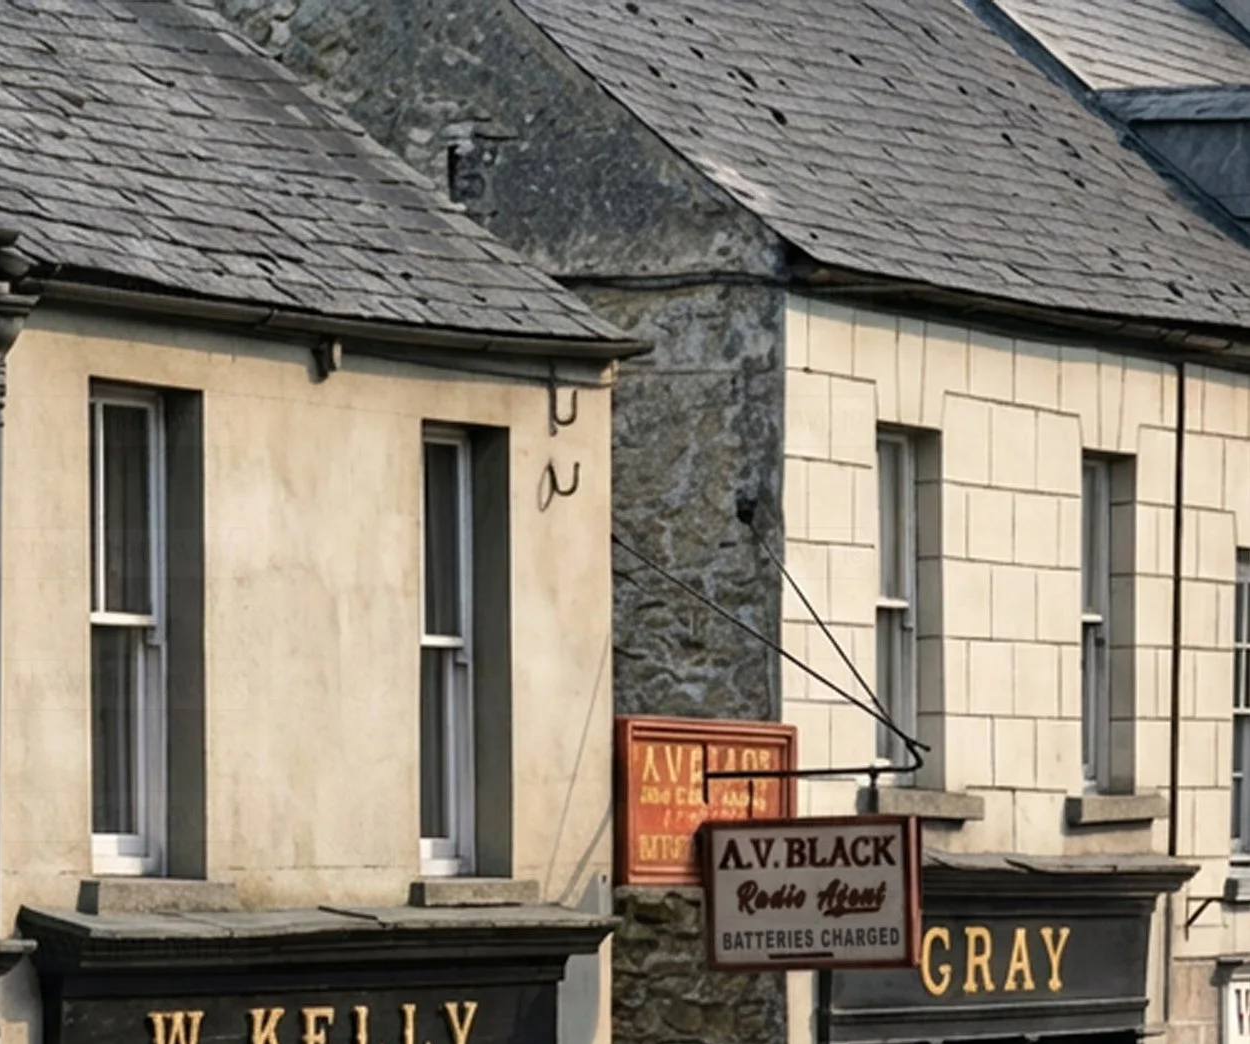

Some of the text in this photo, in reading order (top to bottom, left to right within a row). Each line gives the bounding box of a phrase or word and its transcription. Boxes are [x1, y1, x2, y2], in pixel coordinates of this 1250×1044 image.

[784, 835, 896, 868] BLACK
[736, 878, 886, 917] Radio Agent
[722, 927, 900, 950] BATTERIES CHARGED
[921, 926, 1070, 995] GRAY
